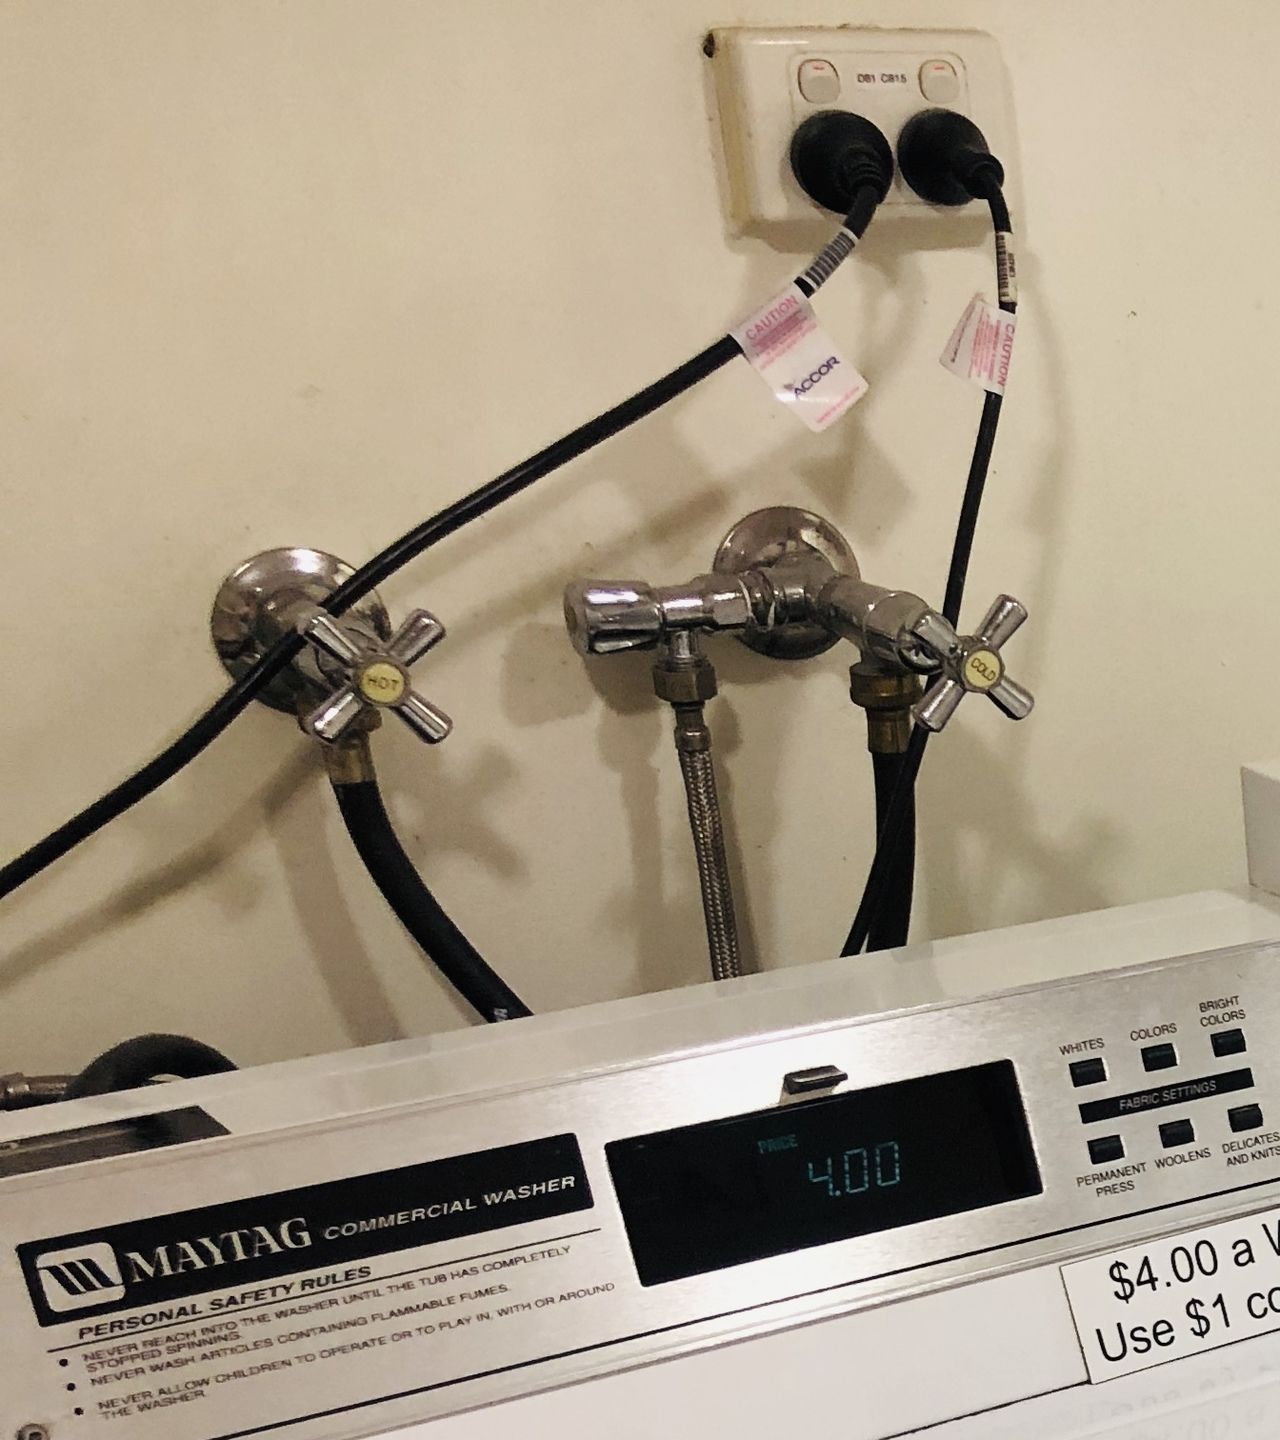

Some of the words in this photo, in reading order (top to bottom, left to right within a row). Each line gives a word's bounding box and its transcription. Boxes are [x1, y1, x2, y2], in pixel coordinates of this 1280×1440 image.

[745, 294, 799, 340] CAUTION
[998, 323, 1015, 386] CAUTION
[794, 356, 840, 398] ACCOR
[971, 657, 996, 681] COLD
[1199, 995, 1240, 1014] BRIGHT
[1200, 1009, 1246, 1028] COLORS
[1130, 1022, 1177, 1042] COLORS
[1059, 1038, 1105, 1057] WHITES
[1119, 1090, 1159, 1111] FABRIC
[1162, 1080, 1217, 1103] SETTINGS
[1221, 1131, 1280, 1155] DELICATES
[808, 1140, 901, 1197] 4.00
[1154, 1147, 1211, 1171] WOOLENS
[1225, 1152, 1250, 1168] AND
[1076, 1161, 1147, 1188] PERMANENT
[1095, 1179, 1136, 1198] PRESS
[124, 1217, 313, 1284] MAYTAG
[324, 1197, 478, 1241] COMMERCIAL
[484, 1175, 576, 1207] WASHER
[1108, 1239, 1218, 1302] $4.00
[1233, 1238, 1256, 1268] a
[78, 1303, 203, 1340] PERSONAL
[209, 1282, 295, 1312] SAFETY
[300, 1266, 371, 1292] RULES
[83, 1342, 138, 1362] NEVER
[142, 1329, 198, 1349] REACH
[201, 1320, 238, 1337] INTO
[240, 1313, 271, 1327] THE
[274, 1298, 341, 1321] WASHER
[342, 1288, 383, 1306] UNTIL
[386, 1279, 415, 1294] THE
[419, 1272, 447, 1287] TUB
[450, 1266, 479, 1281] HAS
[482, 1245, 571, 1274] COMPLETELY
[90, 1366, 146, 1387] NEVER
[150, 1355, 195, 1373] WASH
[200, 1338, 274, 1362] ARTICLES
[277, 1315, 368, 1345] CONTAINING
[371, 1295, 456, 1323] FLAMMABLE
[1095, 1318, 1175, 1363] Use
[1185, 1293, 1231, 1339] $1
[98, 1390, 153, 1410] NEVER
[158, 1377, 210, 1397] ALLOW
[214, 1359, 293, 1384] CHILDREN
[294, 1352, 316, 1364] TO
[320, 1335, 388, 1360] OPERATE
[391, 1329, 413, 1343] OR
[416, 1324, 435, 1337] TO
[439, 1315, 472, 1332] PLAY
[497, 1302, 532, 1318] WITH
[535, 1296, 555, 1308] OR
[558, 1282, 616, 1303] AROUND
[86, 1348, 162, 1374] STOPPED
[101, 1407, 133, 1420] THE
